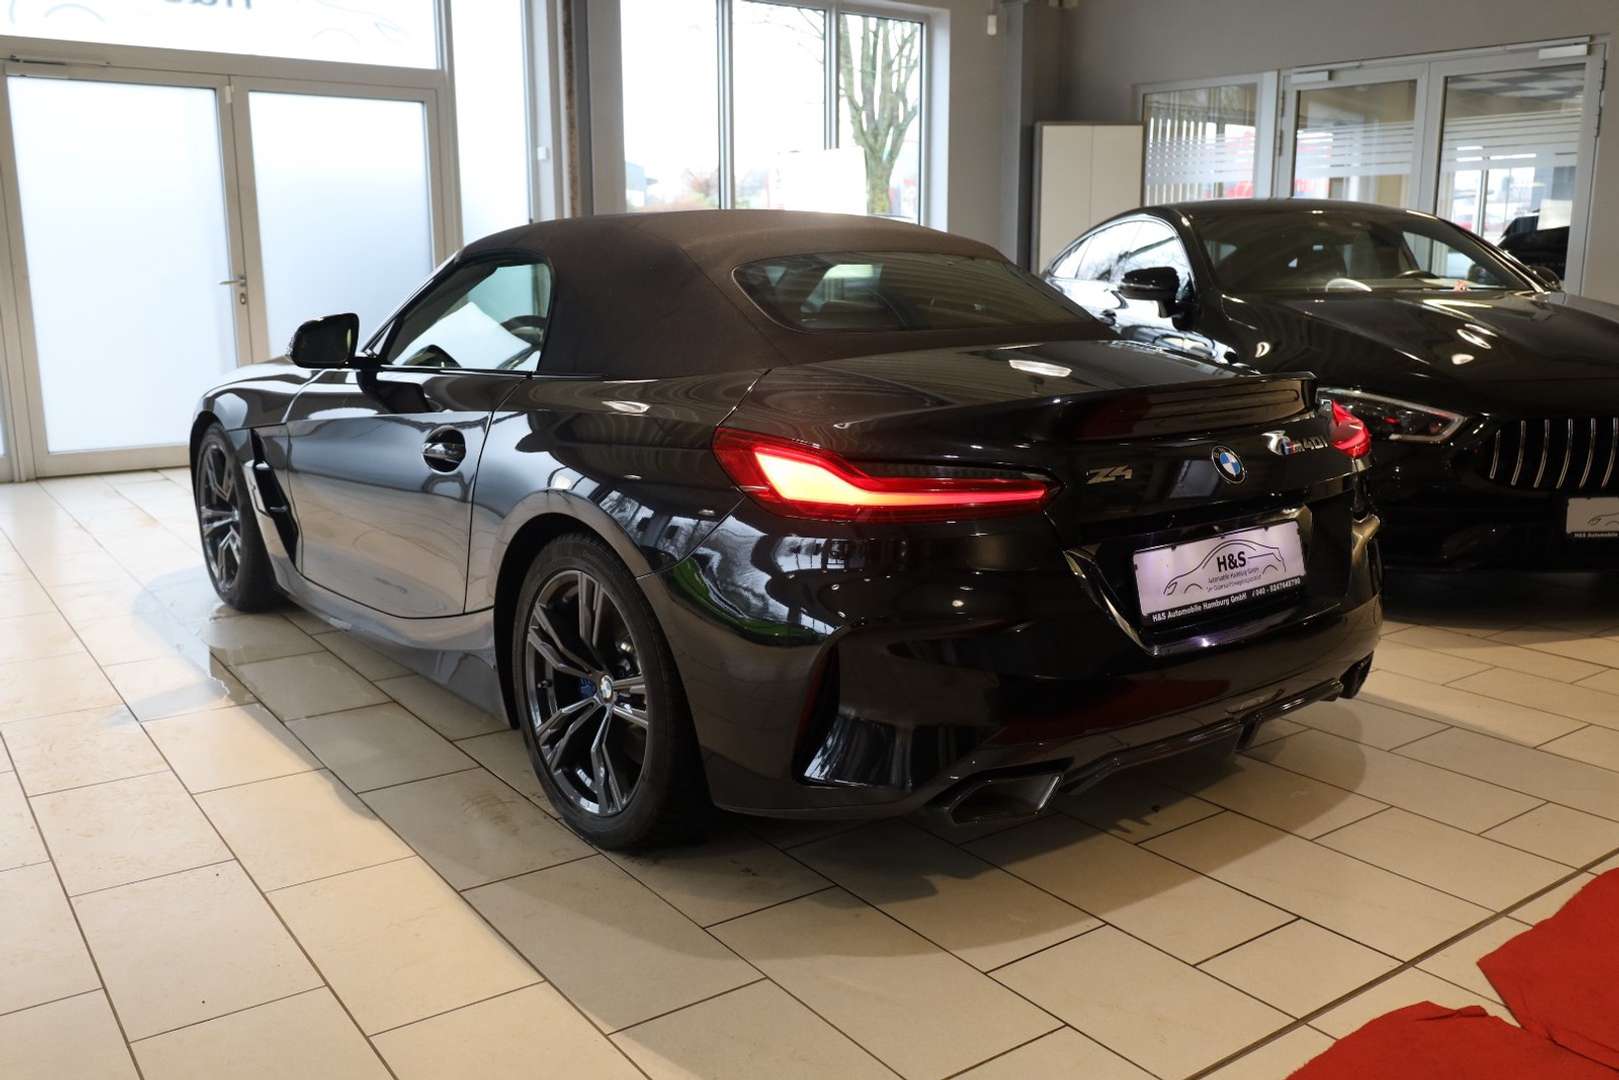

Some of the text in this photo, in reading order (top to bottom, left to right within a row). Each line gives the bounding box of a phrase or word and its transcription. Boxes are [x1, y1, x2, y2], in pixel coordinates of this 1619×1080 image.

[1088, 465, 1132, 484] Z4
[1217, 551, 1246, 573] H&S
[1152, 612, 1167, 622] H&S
[1168, 603, 1202, 618] Automobile
[1203, 597, 1230, 609] Hamburg
